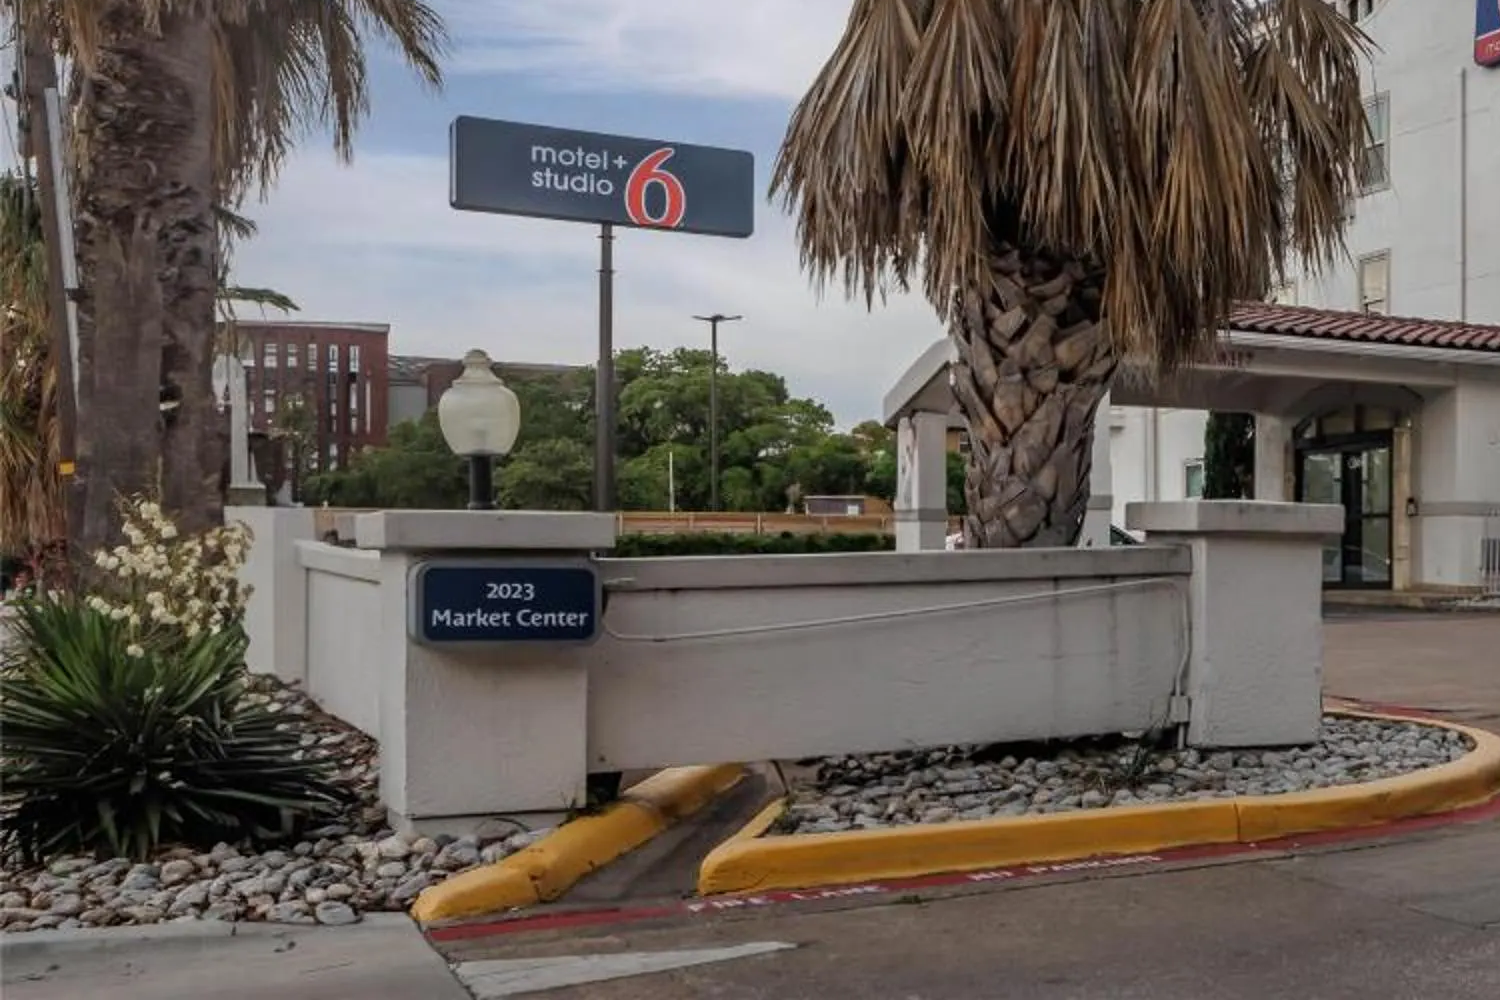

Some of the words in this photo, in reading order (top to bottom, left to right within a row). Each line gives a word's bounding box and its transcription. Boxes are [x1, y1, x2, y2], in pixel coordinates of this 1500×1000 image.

[531, 168, 613, 195] studio
[625, 147, 686, 228] 6
[487, 583, 535, 600] 2023
[432, 608, 511, 627] Market
[516, 609, 589, 627] Center
